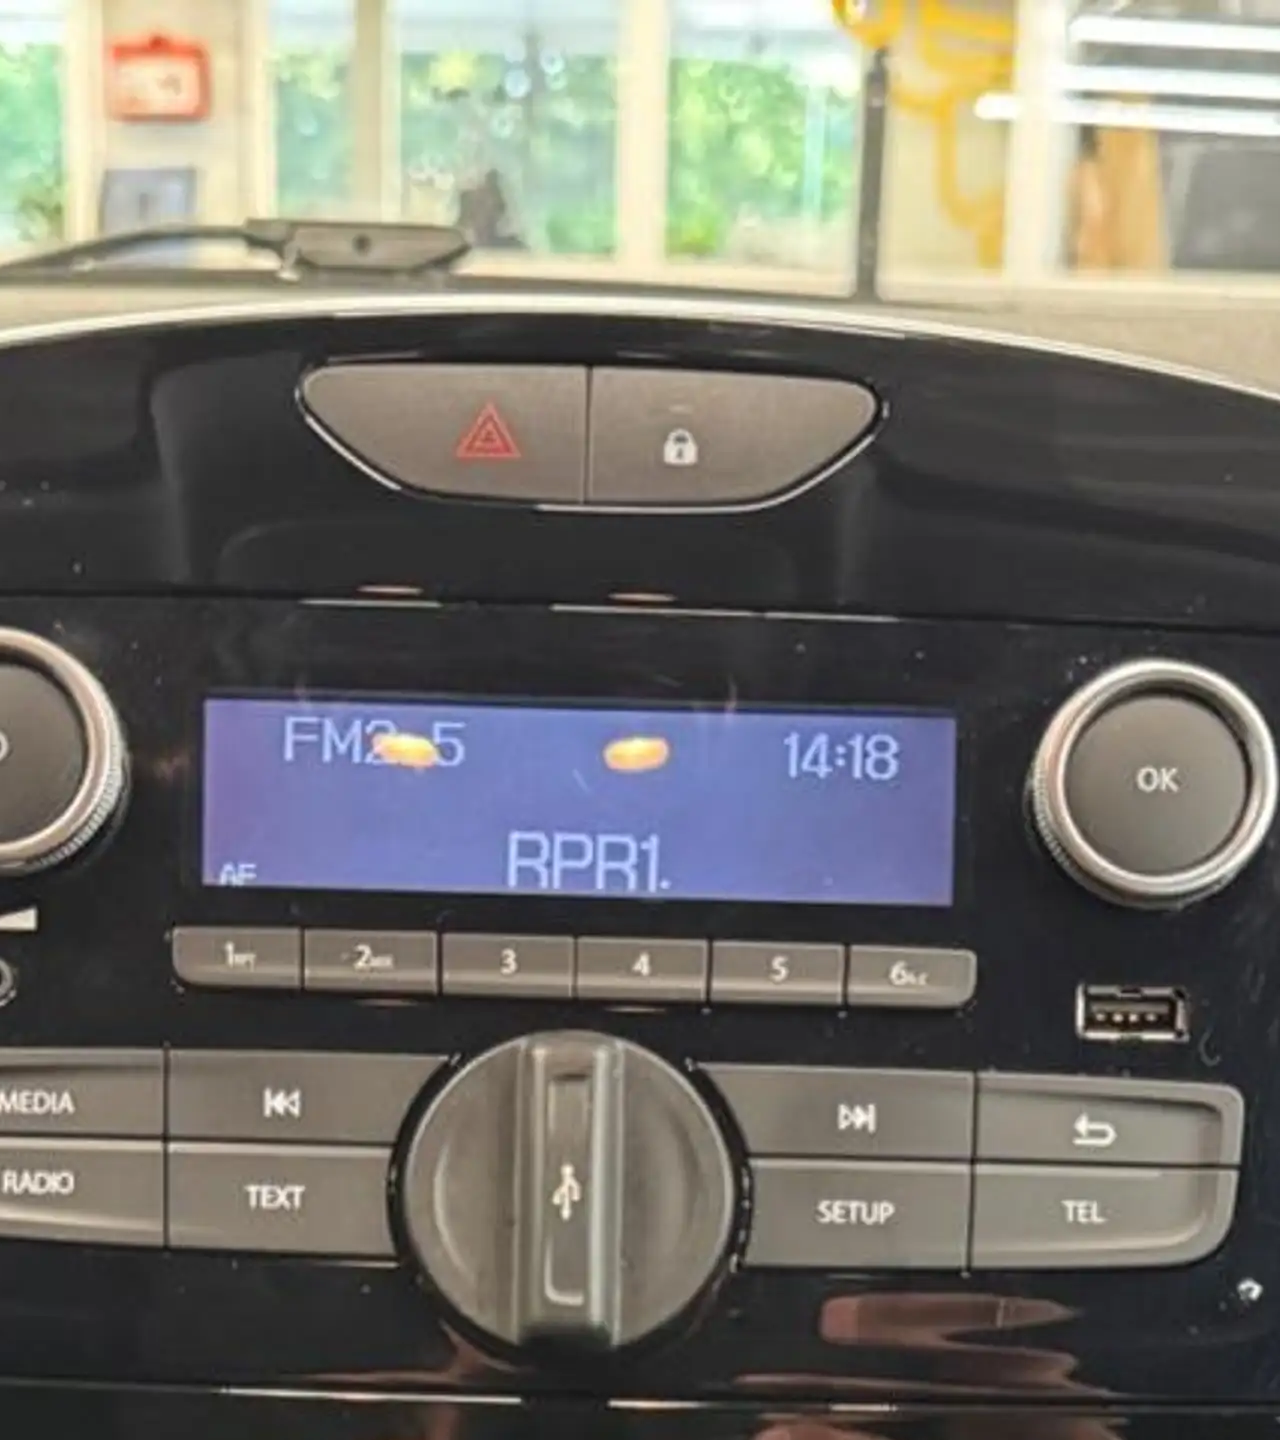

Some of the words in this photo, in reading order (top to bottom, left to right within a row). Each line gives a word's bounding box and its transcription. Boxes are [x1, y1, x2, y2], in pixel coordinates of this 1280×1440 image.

[784, 732, 900, 780] 14:18
[1136, 765, 1179, 793] OK
[500, 948, 518, 975] 3
[632, 952, 651, 976] 4
[770, 956, 789, 983] 5
[1, 1170, 75, 1195] RADIO
[244, 1184, 306, 1210] TEXT
[816, 1200, 896, 1225] SETUP
[1061, 1200, 1108, 1224] TEL
